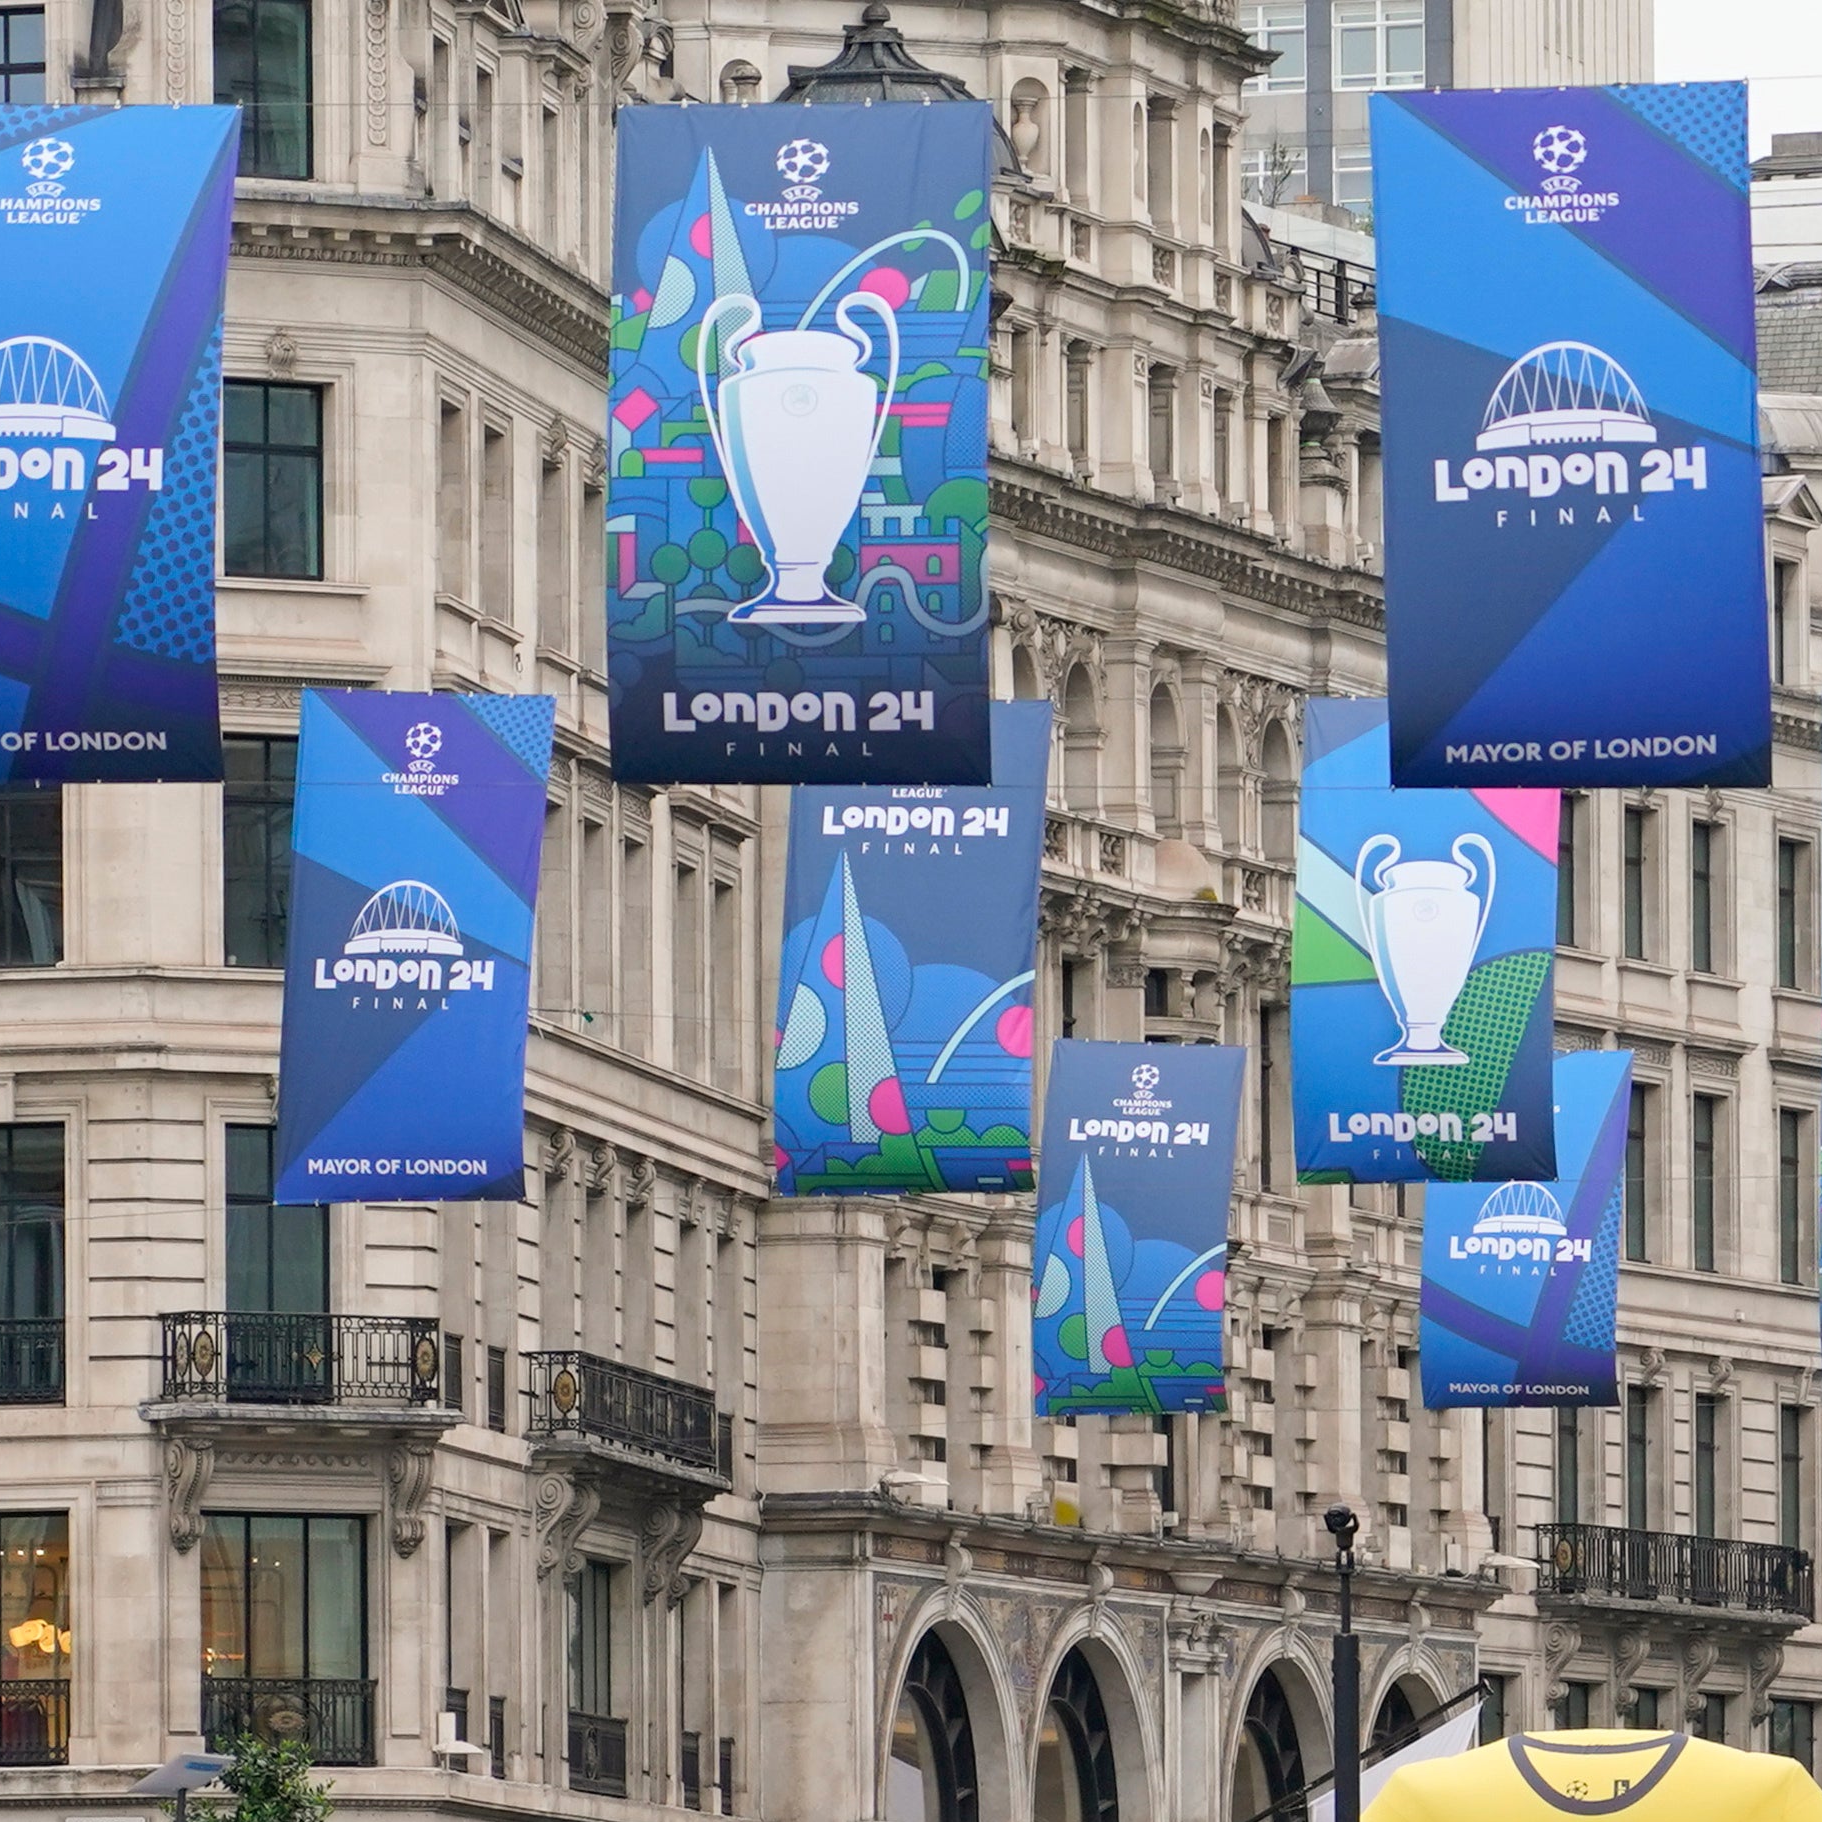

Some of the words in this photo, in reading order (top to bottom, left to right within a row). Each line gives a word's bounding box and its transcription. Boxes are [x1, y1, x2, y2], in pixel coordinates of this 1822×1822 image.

[744, 201, 860, 217] CHAMPIONS
[1504, 192, 1621, 211] CHAMPIONS
[7, 210, 82, 225] LEAGUE
[764, 215, 841, 231] LEAGUE
[1525, 207, 1601, 225] LEAGUE
[97, 447, 165, 491] 24
[1639, 446, 1707, 494] 24
[1496, 505, 1645, 527] FINAL
[868, 690, 935, 731] 24
[0, 732, 37, 751] OF
[44, 732, 167, 751] LONDON
[726, 740, 873, 757] FINAL
[1445, 742, 1541, 762] MAYOR
[1550, 740, 1587, 760] OF
[1596, 734, 1718, 758] LONDON
[382, 773, 460, 786] CHAMPIONS
[394, 783, 446, 796] LEAGUE
[892, 787, 944, 798] LEAGUE
[963, 806, 1009, 838] 24
[862, 841, 962, 856] FINAL
[448, 958, 495, 990] 24
[352, 996, 450, 1010] FINAL
[1113, 1098, 1173, 1110] CHAMPIONS
[1122, 1106, 1162, 1116] LEAGUE
[1173, 1122, 1210, 1146] 24
[1471, 1111, 1517, 1142] 24
[1098, 1146, 1175, 1159] FINAL
[1373, 1148, 1479, 1161] FINAL
[307, 1158, 372, 1175] MAYOR
[375, 1158, 402, 1174] OF
[405, 1158, 487, 1175] LONDON
[1556, 1236, 1592, 1262] 24
[1480, 1264, 1557, 1277] FINAL
[1449, 1382, 1500, 1395] MAYOR
[1504, 1383, 1521, 1395] OF
[1524, 1384, 1590, 1396] LONDON
